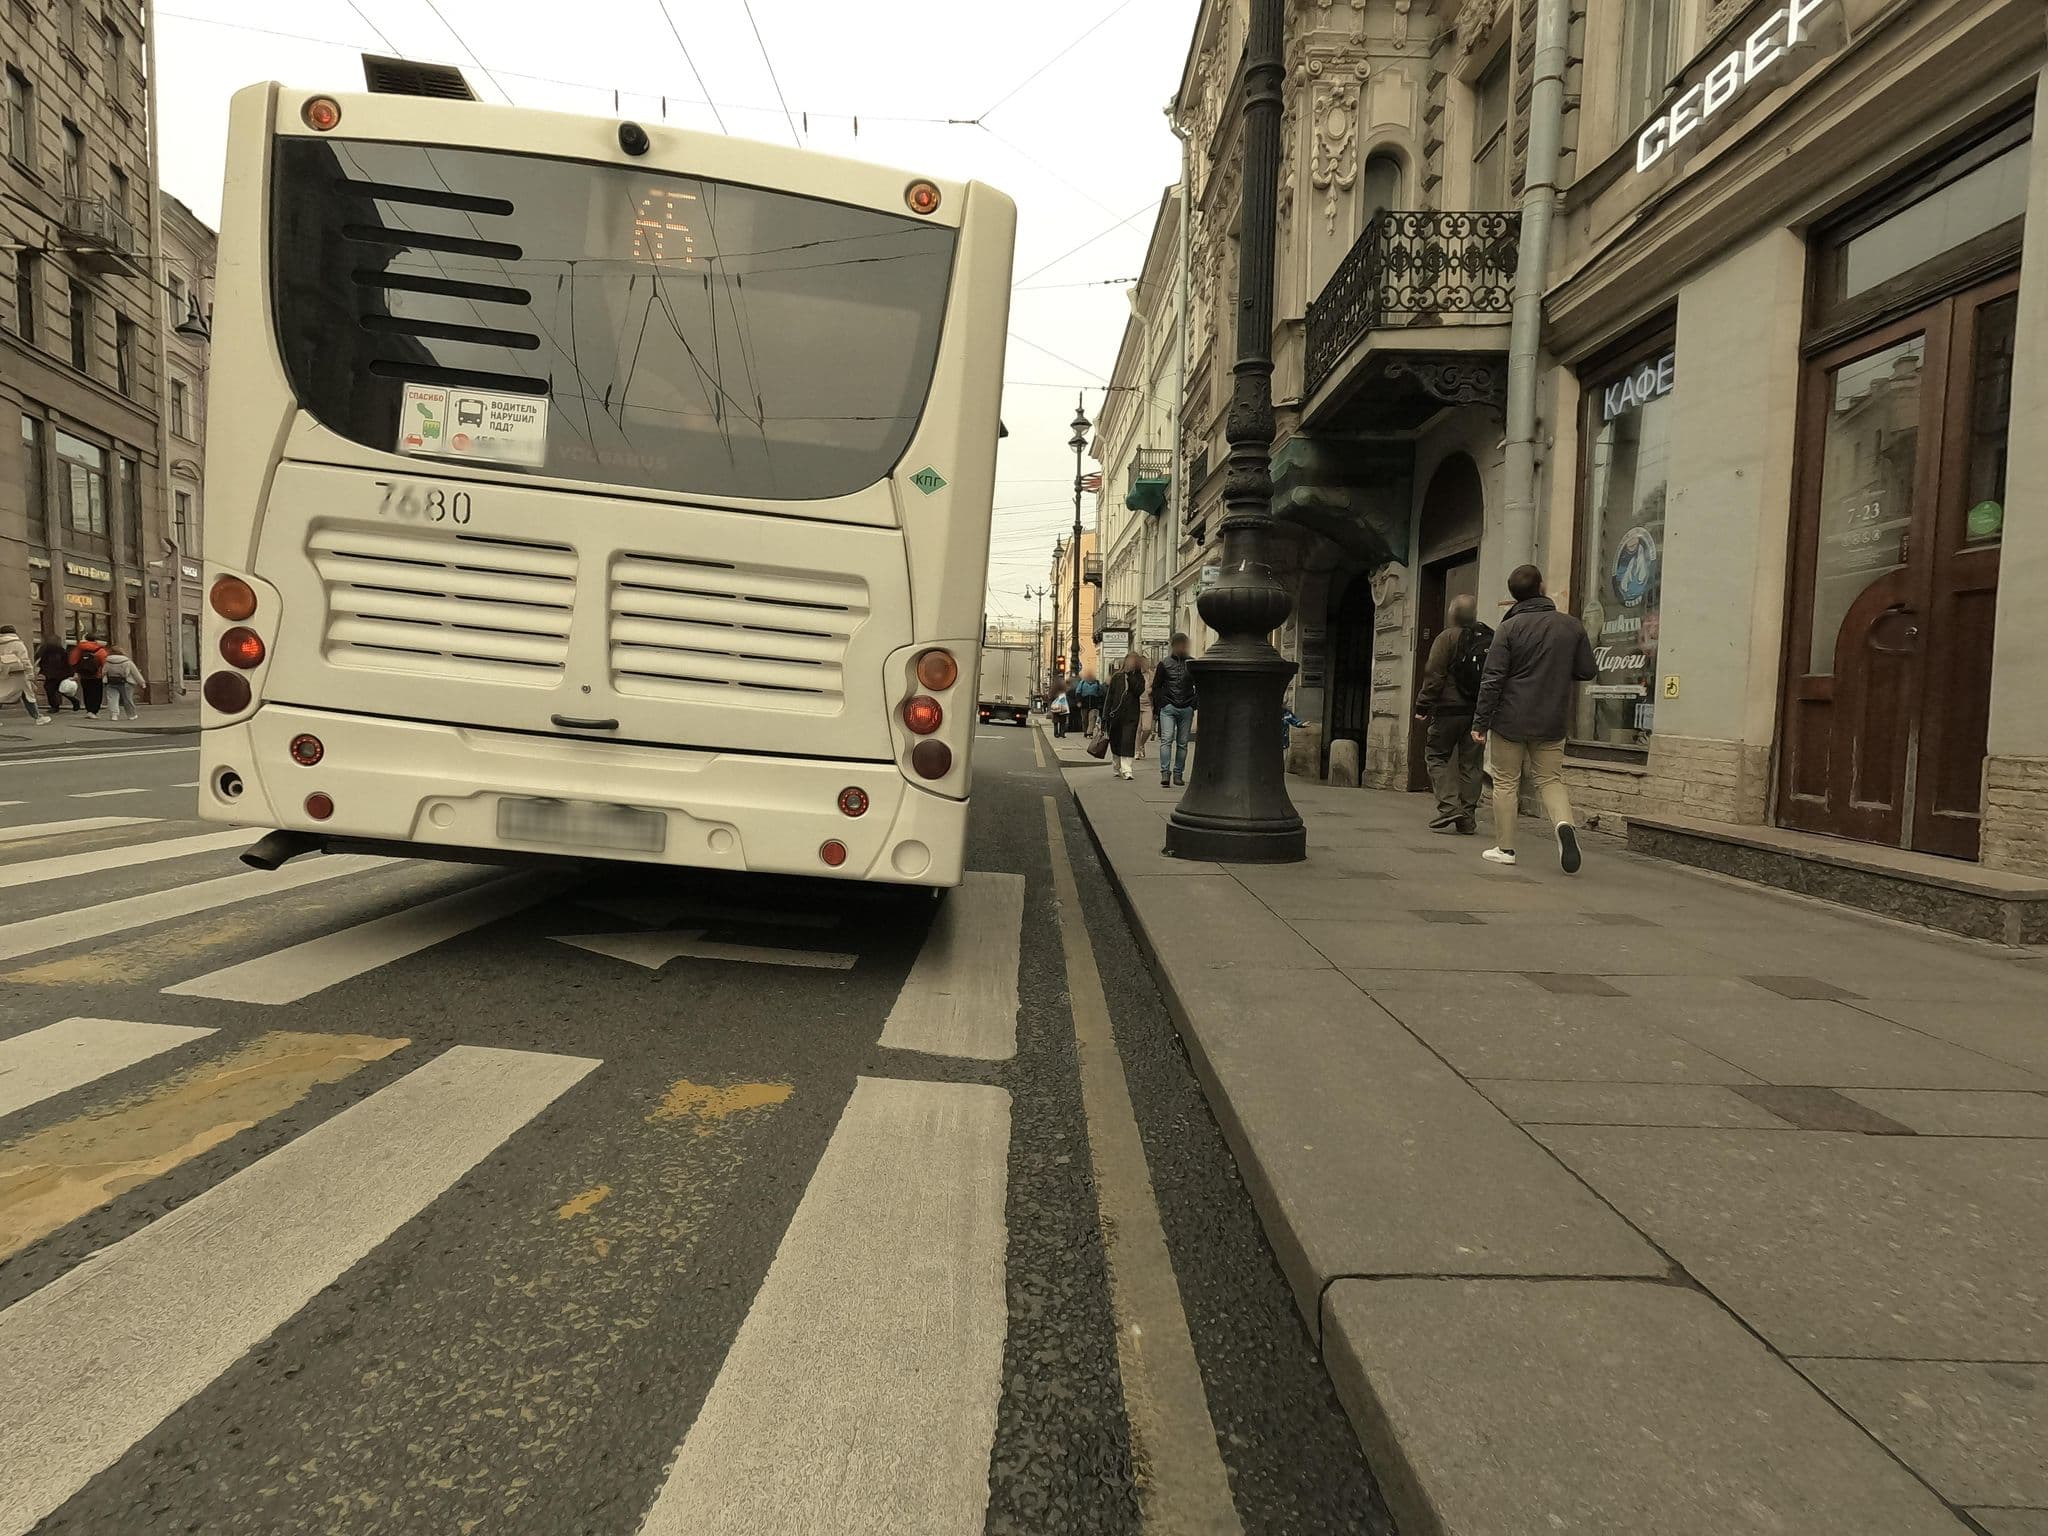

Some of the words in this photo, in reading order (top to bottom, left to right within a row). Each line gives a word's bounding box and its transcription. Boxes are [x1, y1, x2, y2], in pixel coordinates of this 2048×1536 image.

[1604, 351, 1675, 420] КАФЕ
[408, 391, 444, 402] СПАСИБО
[491, 401, 537, 414] ВОДИТЕЛЬ
[490, 411, 534, 424] НАРУШИЛ
[489, 421, 514, 433] ПДД?
[916, 474, 941, 487] КПГ
[1847, 502, 1880, 524] 7-23
[1593, 646, 1646, 672] Пироги
